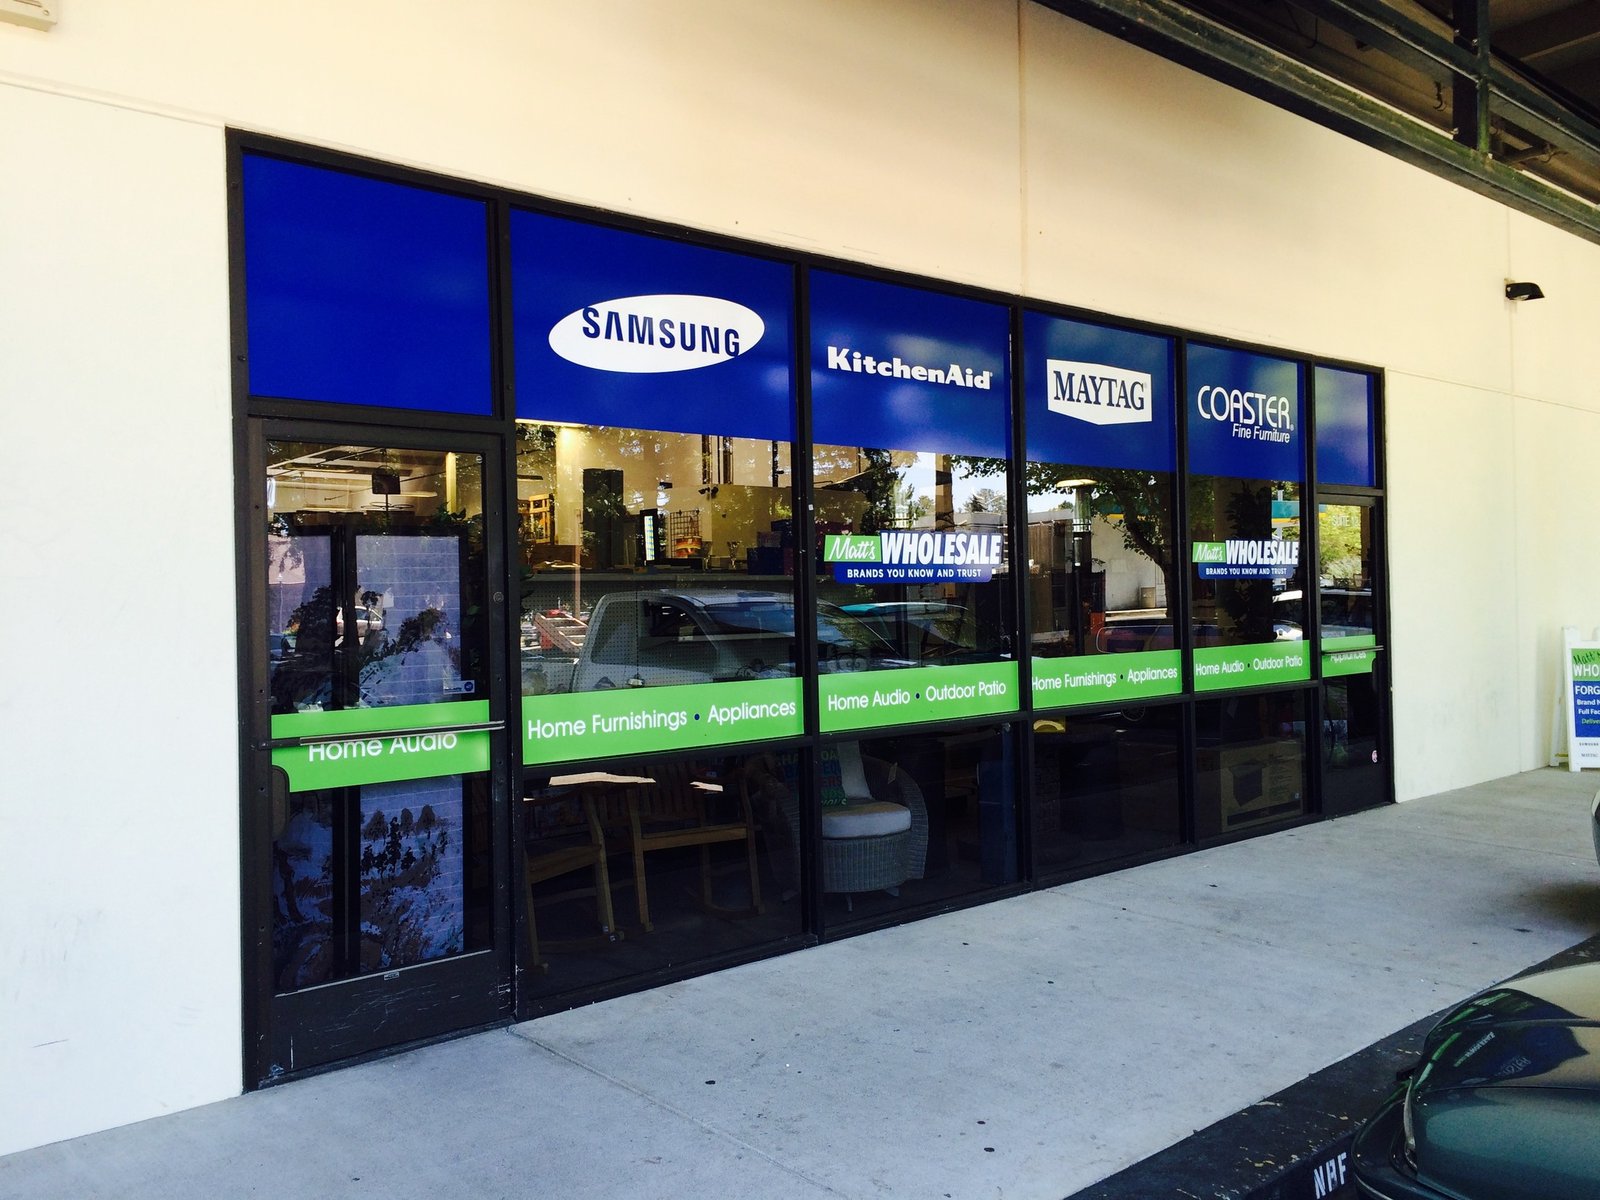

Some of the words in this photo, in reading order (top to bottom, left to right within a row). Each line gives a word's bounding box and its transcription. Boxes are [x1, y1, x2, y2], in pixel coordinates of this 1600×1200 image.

[582, 307, 740, 358] SAMSUNG
[827, 345, 992, 390] KitchenAid
[1053, 370, 1145, 411] MAYTAG
[1197, 385, 1291, 431] COASTER
[1232, 423, 1252, 439] Fine
[1253, 426, 1290, 443] Furniture
[828, 537, 876, 560] Matt's
[881, 532, 1003, 565] WHOLESALE
[1195, 543, 1223, 562] Matt's
[1225, 540, 1299, 565] WHOLESALE
[847, 568, 884, 578] BRANDS
[887, 568, 905, 578] YOU
[908, 568, 934, 578] KNOW
[937, 568, 954, 578] AND
[957, 568, 981, 577] TRUST
[1205, 567, 1228, 576] BRANDS
[1229, 567, 1241, 576] YOU
[1242, 567, 1258, 575] KNOW
[1259, 567, 1271, 575] AND
[1271, 567, 1287, 575] TRUST
[1032, 676, 1062, 691] Home
[1064, 671, 1117, 688] Furnishings
[1127, 667, 1178, 684] Appliances
[1195, 663, 1220, 676] Home
[1222, 660, 1245, 673] Audio
[1253, 657, 1284, 671] Outdoor
[1285, 655, 1303, 668] Patio
[828, 694, 869, 712] Home
[872, 689, 911, 707] Audio
[925, 685, 976, 702] Outdoor
[978, 680, 1007, 697] Patio
[528, 719, 586, 740] Home
[592, 709, 688, 732] Furnishings
[707, 701, 797, 726] Appliances
[309, 740, 382, 762] Home
[389, 732, 457, 754] Audio
